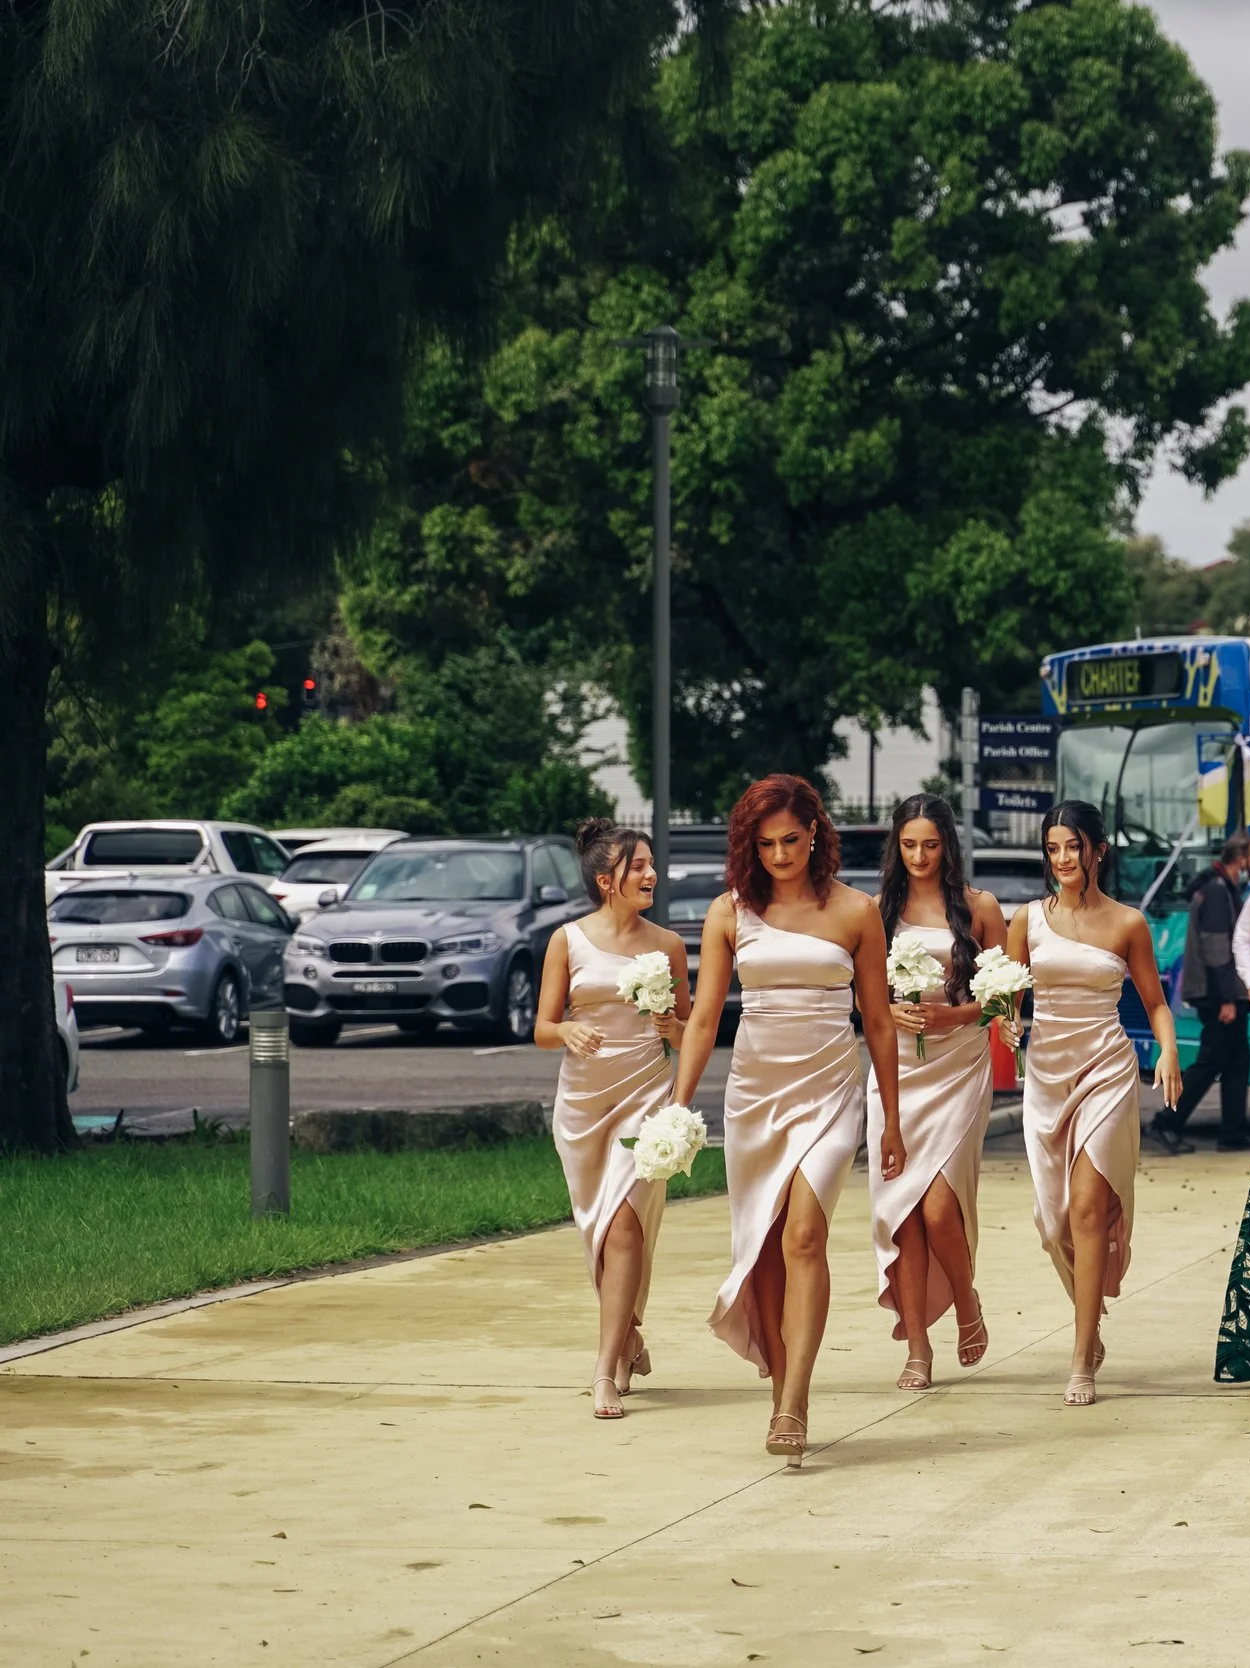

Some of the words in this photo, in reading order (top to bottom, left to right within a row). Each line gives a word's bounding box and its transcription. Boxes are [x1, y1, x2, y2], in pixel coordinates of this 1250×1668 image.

[981, 721, 1015, 734] Parish
[1016, 721, 1052, 733] Centre
[983, 745, 1017, 757] Parish
[1018, 744, 1051, 758] Office
[997, 792, 1038, 808] Toilets
